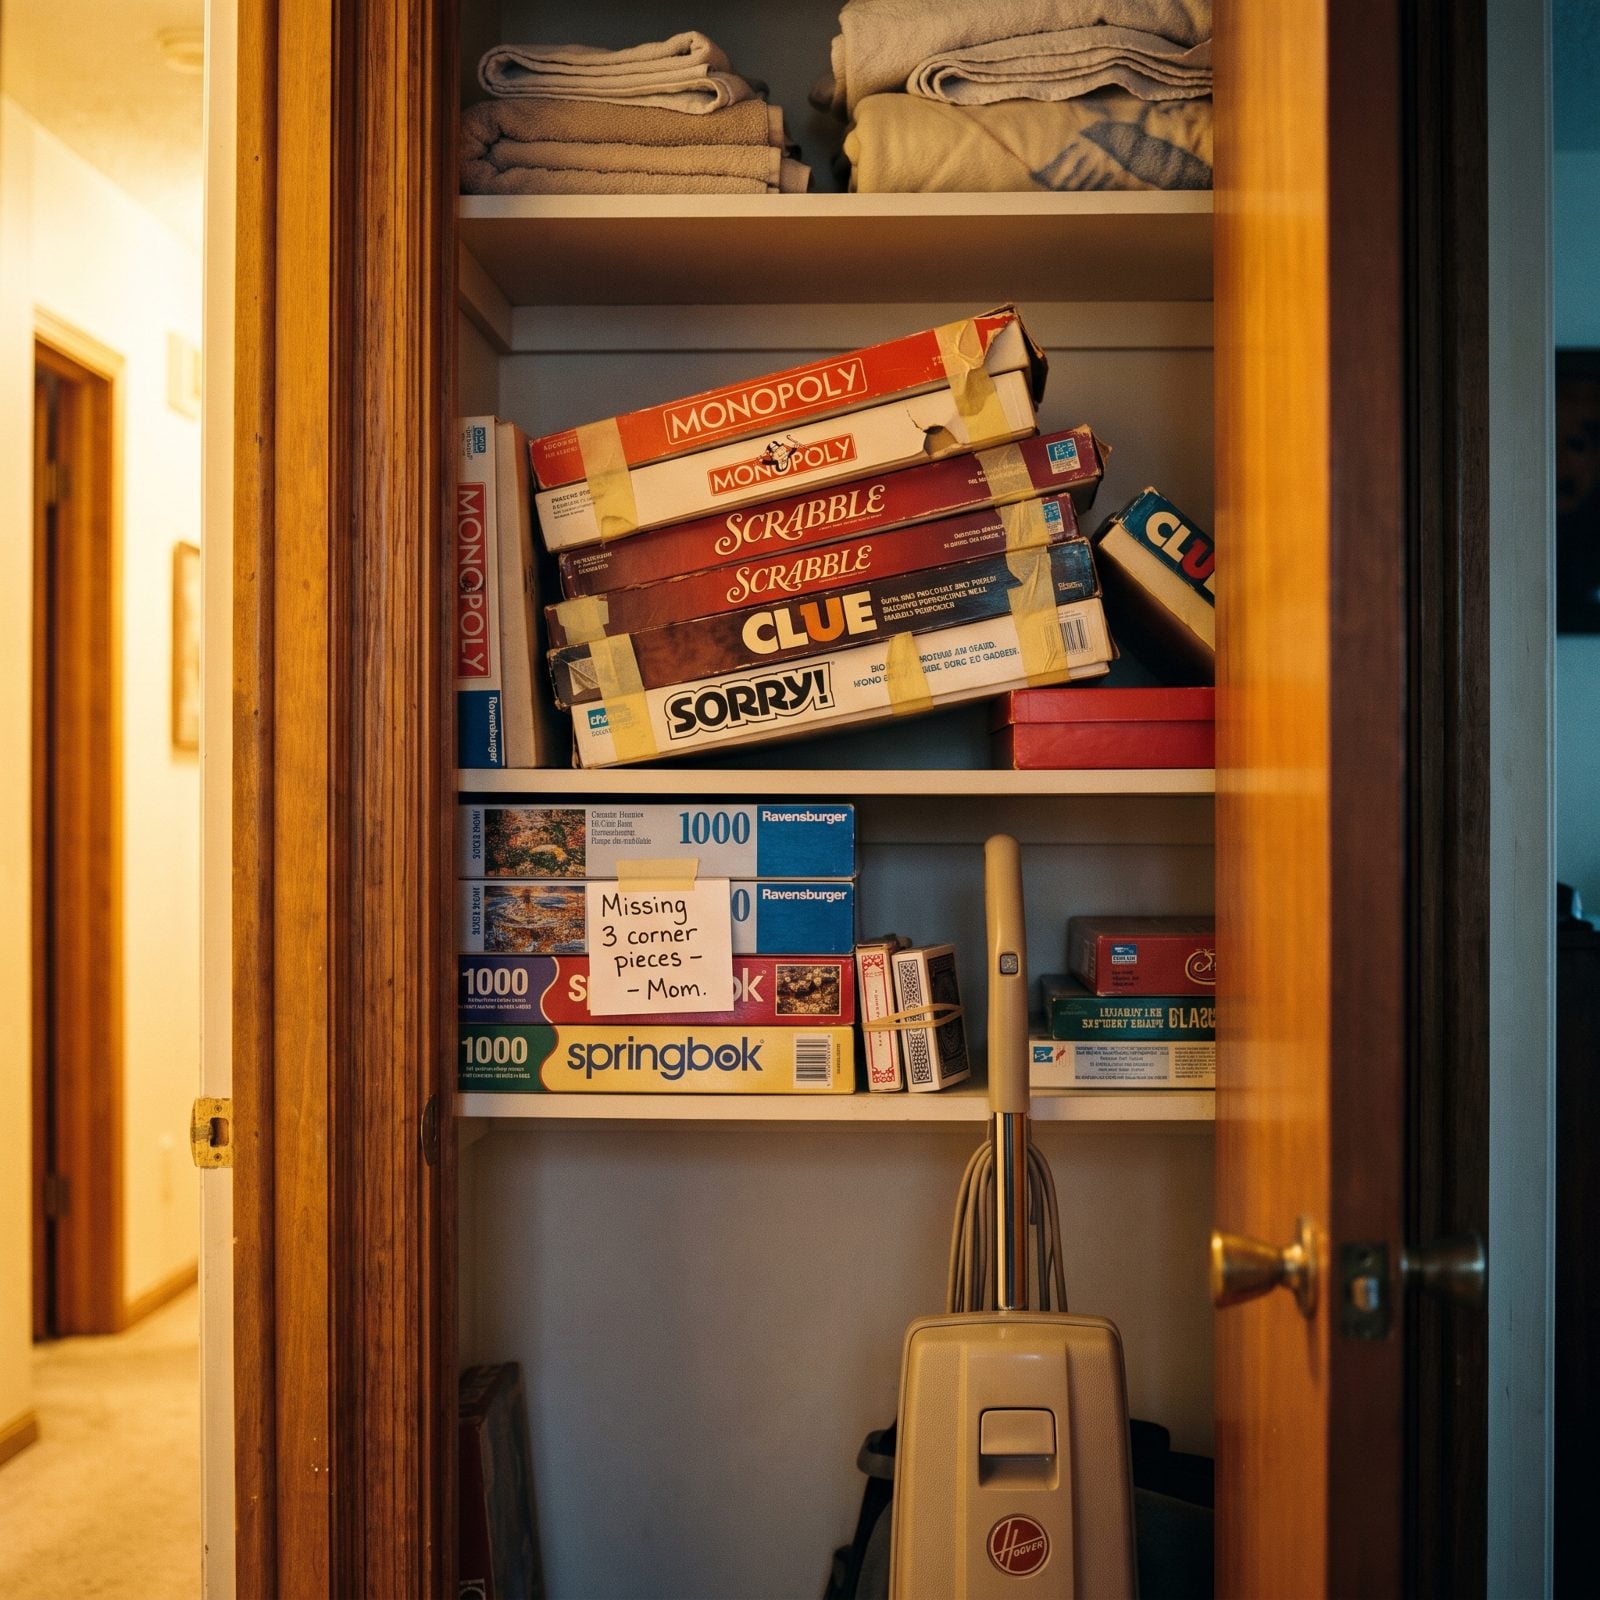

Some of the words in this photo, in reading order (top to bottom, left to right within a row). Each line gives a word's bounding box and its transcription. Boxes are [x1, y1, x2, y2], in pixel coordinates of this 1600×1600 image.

[671, 364, 857, 439] MONOPOLY
[714, 484, 886, 556] SCRABBLE
[1145, 511, 1215, 597] CLU
[458, 490, 485, 671] MONOPOLY
[726, 545, 872, 604] SCRABBLE
[741, 590, 878, 655] CLUE
[667, 667, 831, 736] SORRY!
[679, 811, 751, 845] 1000
[762, 810, 847, 825] Ravensburger
[602, 893, 688, 926] Missing
[762, 888, 847, 903] Ravensburger
[602, 925, 618, 947] 3
[627, 927, 698, 945] corner
[614, 951, 682, 977] pieces
[462, 967, 529, 996] 1000
[647, 977, 707, 1001] Mom.
[461, 1036, 528, 1065] 1000
[567, 1036, 764, 1081] springbok
